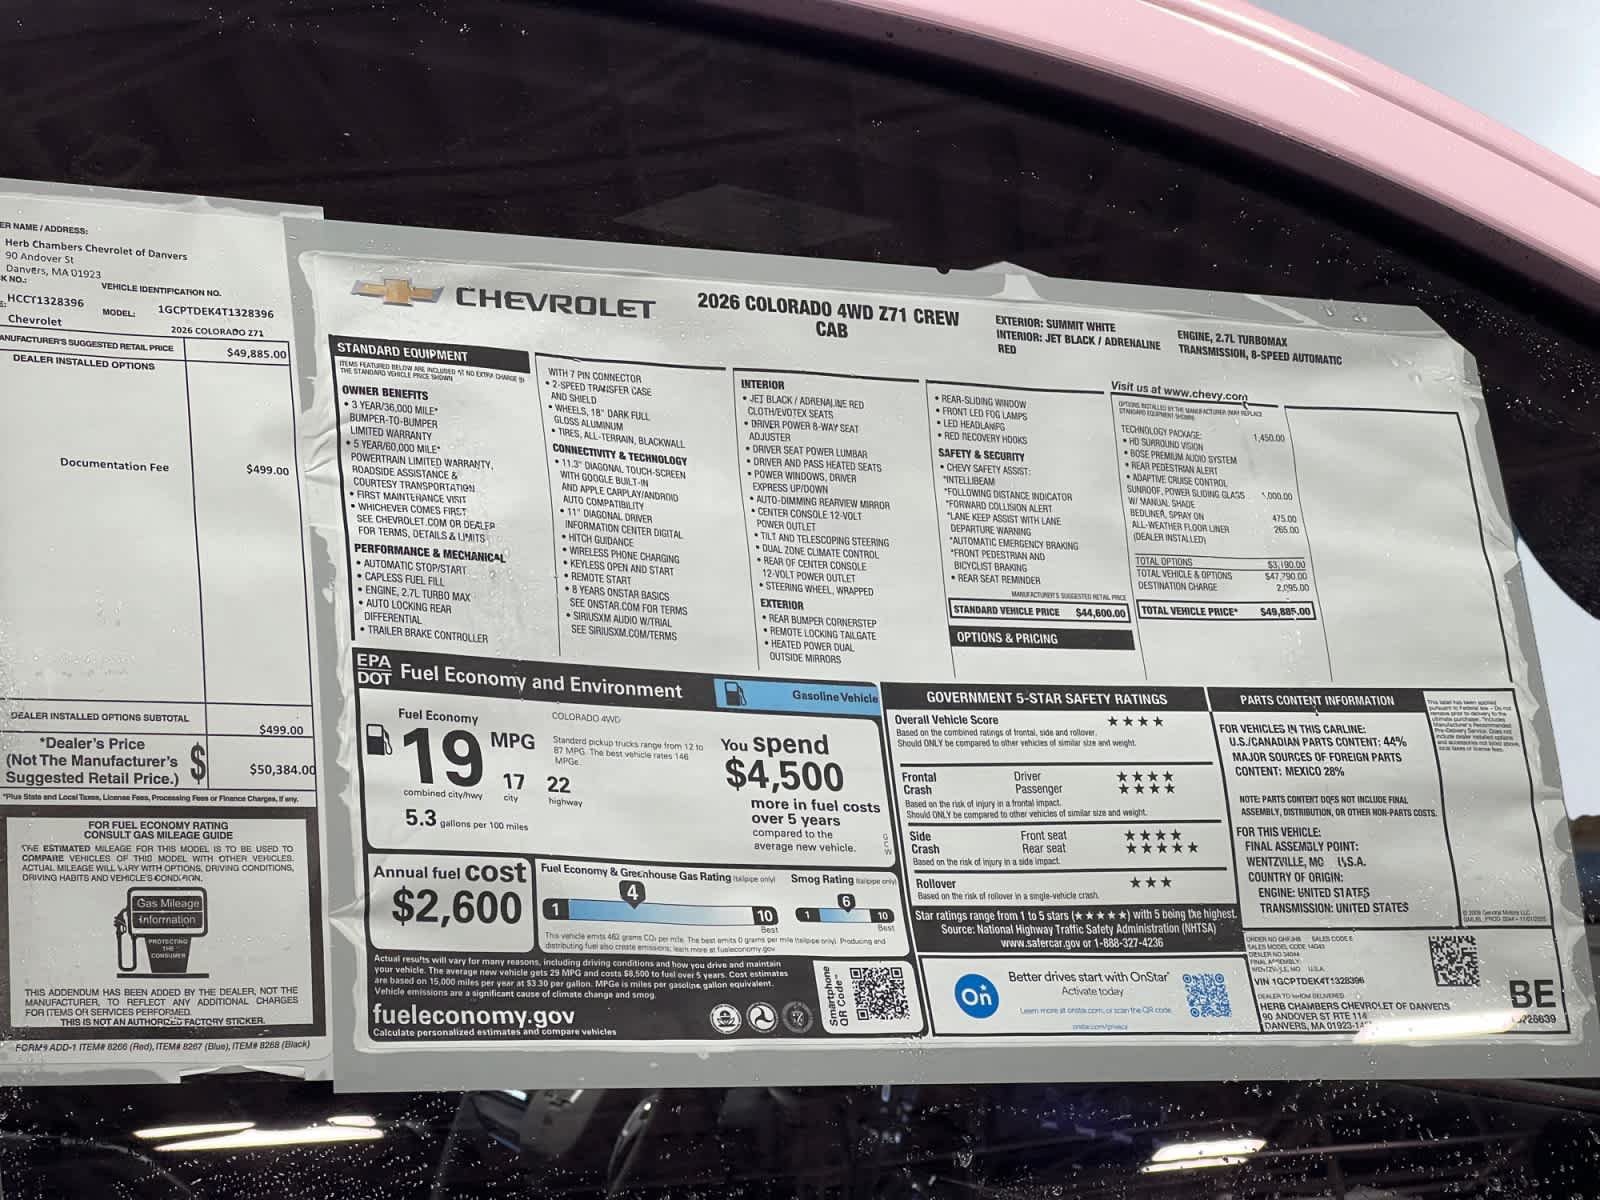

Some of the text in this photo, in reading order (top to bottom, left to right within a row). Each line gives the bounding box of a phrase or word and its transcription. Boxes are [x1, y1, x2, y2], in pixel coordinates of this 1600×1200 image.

[5, 238, 29, 247] Herb
[32, 240, 83, 251] Chambers
[85, 244, 132, 256] Chevrolet
[148, 249, 188, 260] Danvers
[5, 251, 74, 264] 90 Andover St
[6, 264, 101, 279] Danvers, MA 01923
[456, 287, 656, 319] CHEVROLET
[698, 292, 959, 326] 2026 COLORADO 4WD Z71 CREW
[8, 314, 62, 326] Chevrolet
[102, 308, 136, 317] MODEL:
[816, 321, 848, 338] CAB
[996, 315, 1116, 332] EXTERIOR: SUMMIT WHITE
[996, 329, 1042, 342] INTERIOR:
[1045, 333, 1062, 343] JET
[1064, 334, 1096, 345] BLACK
[1105, 337, 1161, 350] ADRENALINE
[1177, 330, 1287, 347] ENGINE, 2.7L TURBOMAX
[227, 348, 287, 359] $49,885.00
[337, 342, 468, 361] STANDARD EQUIPMENT
[998, 344, 1016, 354] RED
[1178, 344, 1342, 365] TRANSMISSION, 8-SPEED AUTOMATIC
[13, 354, 155, 370] DEALER INSTALLED OPTIONS
[741, 379, 784, 390] INTERIOR
[1111, 381, 1248, 401] Visit us at www.chevy.com
[342, 385, 428, 400] OWNER BENEFITS
[350, 426, 432, 440] LIMITED WARRANTY
[938, 448, 1024, 462] SAFETY & SECURITY
[60, 457, 169, 472] Documentation Fee
[246, 464, 289, 476] $499.00
[1272, 514, 1297, 523] 475.00
[760, 598, 804, 610] EXTERIOR
[1141, 606, 1169, 615] TOTAL
[1170, 606, 1206, 616] VEHICLE
[953, 605, 1126, 619] STANDARD VEHICLE PRICE $44,600.00
[368, 625, 488, 644] TRAILER BRAKE CONTROLLER
[957, 632, 1058, 644] OPTIONS & PRICING
[357, 653, 391, 668] EPA
[358, 671, 392, 685] DOT
[401, 664, 683, 698] Fuel Economy and Environment
[792, 690, 878, 703] Gasoline Vehicle
[927, 691, 1168, 705] GOVERNMENT 5-STAR SAFETY RATINGS
[1240, 695, 1395, 706] PARTS CONTENT INFORMATION
[399, 708, 478, 726] Fuel Economy
[895, 714, 999, 725] Overall Vehicle Score
[259, 725, 304, 736] $499.00
[109, 738, 145, 750] Price
[721, 734, 829, 758] You spend
[6, 753, 37, 768] (Not
[39, 754, 67, 766] The
[190, 742, 317, 785] $ $50,384.00
[403, 728, 535, 787] 19 MPG
[725, 755, 843, 793] $4,500
[902, 771, 1041, 782] Frontal Driver
[1235, 766, 1345, 776] CONTENT: MEXICO 28%
[6, 771, 179, 787] Suggested Retail Price.)
[503, 773, 571, 793] 17 22
[904, 784, 1063, 796] Crash Passenger
[403, 789, 583, 808] combined city/hwy city highway
[751, 798, 880, 813] more in fuel costs
[88, 821, 228, 830] FOR FUEL ECONOMY RATING
[406, 809, 436, 826] 5.3
[440, 819, 471, 829] gallons
[490, 821, 504, 829] 100
[506, 823, 528, 831] miles
[752, 813, 840, 828] over 5 years
[84, 830, 233, 840] CONSULT GAS MILEAGE GUIDE
[1236, 826, 1321, 837] FOR THIS VEHICLE:
[373, 862, 527, 883] Annual fuel cost
[916, 878, 956, 888] Rollover
[627, 884, 851, 907] 4 6
[392, 885, 522, 928] $2,600
[1001, 937, 1164, 950] www.safercar.gov or 1-888-327-4236
[1008, 971, 1128, 982] Better drives start with
[962, 988, 992, 1006] On
[1509, 979, 1556, 1008] BE
[373, 1003, 574, 1028] fueleconomy.gov
